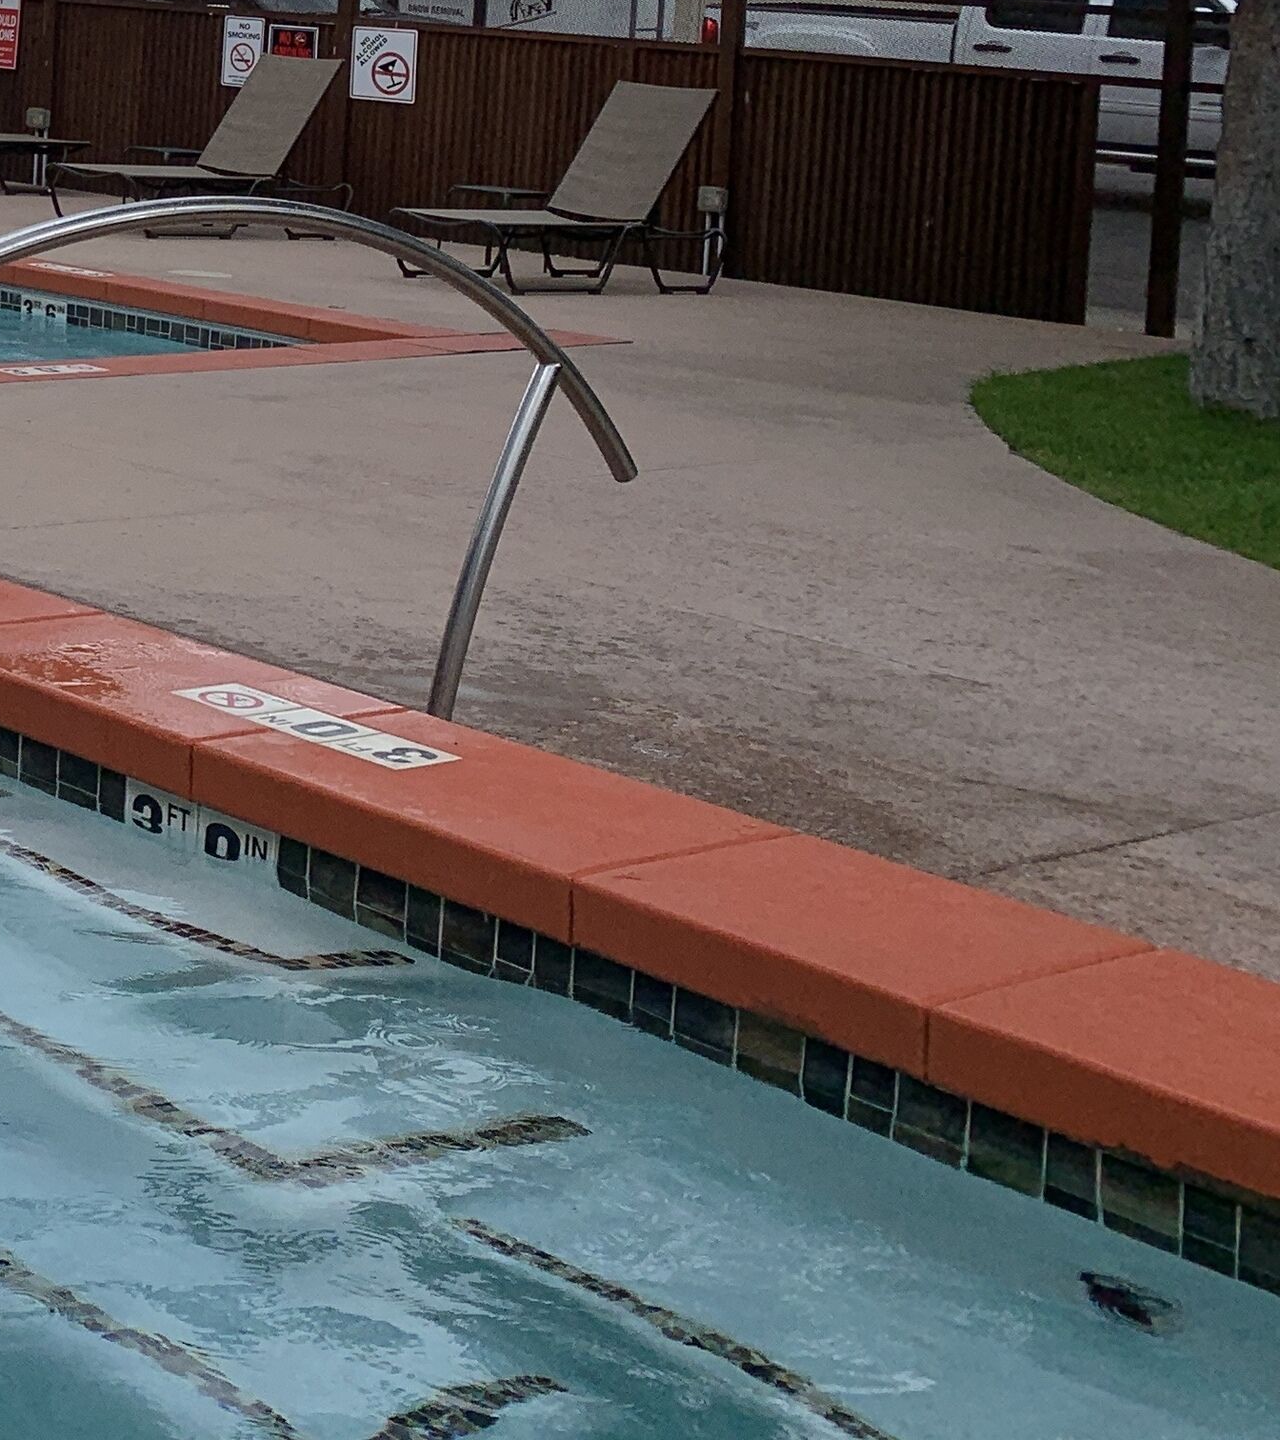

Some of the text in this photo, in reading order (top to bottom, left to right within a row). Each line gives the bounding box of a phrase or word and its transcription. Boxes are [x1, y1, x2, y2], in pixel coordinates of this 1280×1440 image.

[227, 31, 261, 40] SMOKING
[355, 33, 384, 61] ALCOHOL
[360, 36, 371, 47] NO
[360, 37, 388, 67] ALLOWED
[132, 794, 268, 861] 3 FT 0 IN
